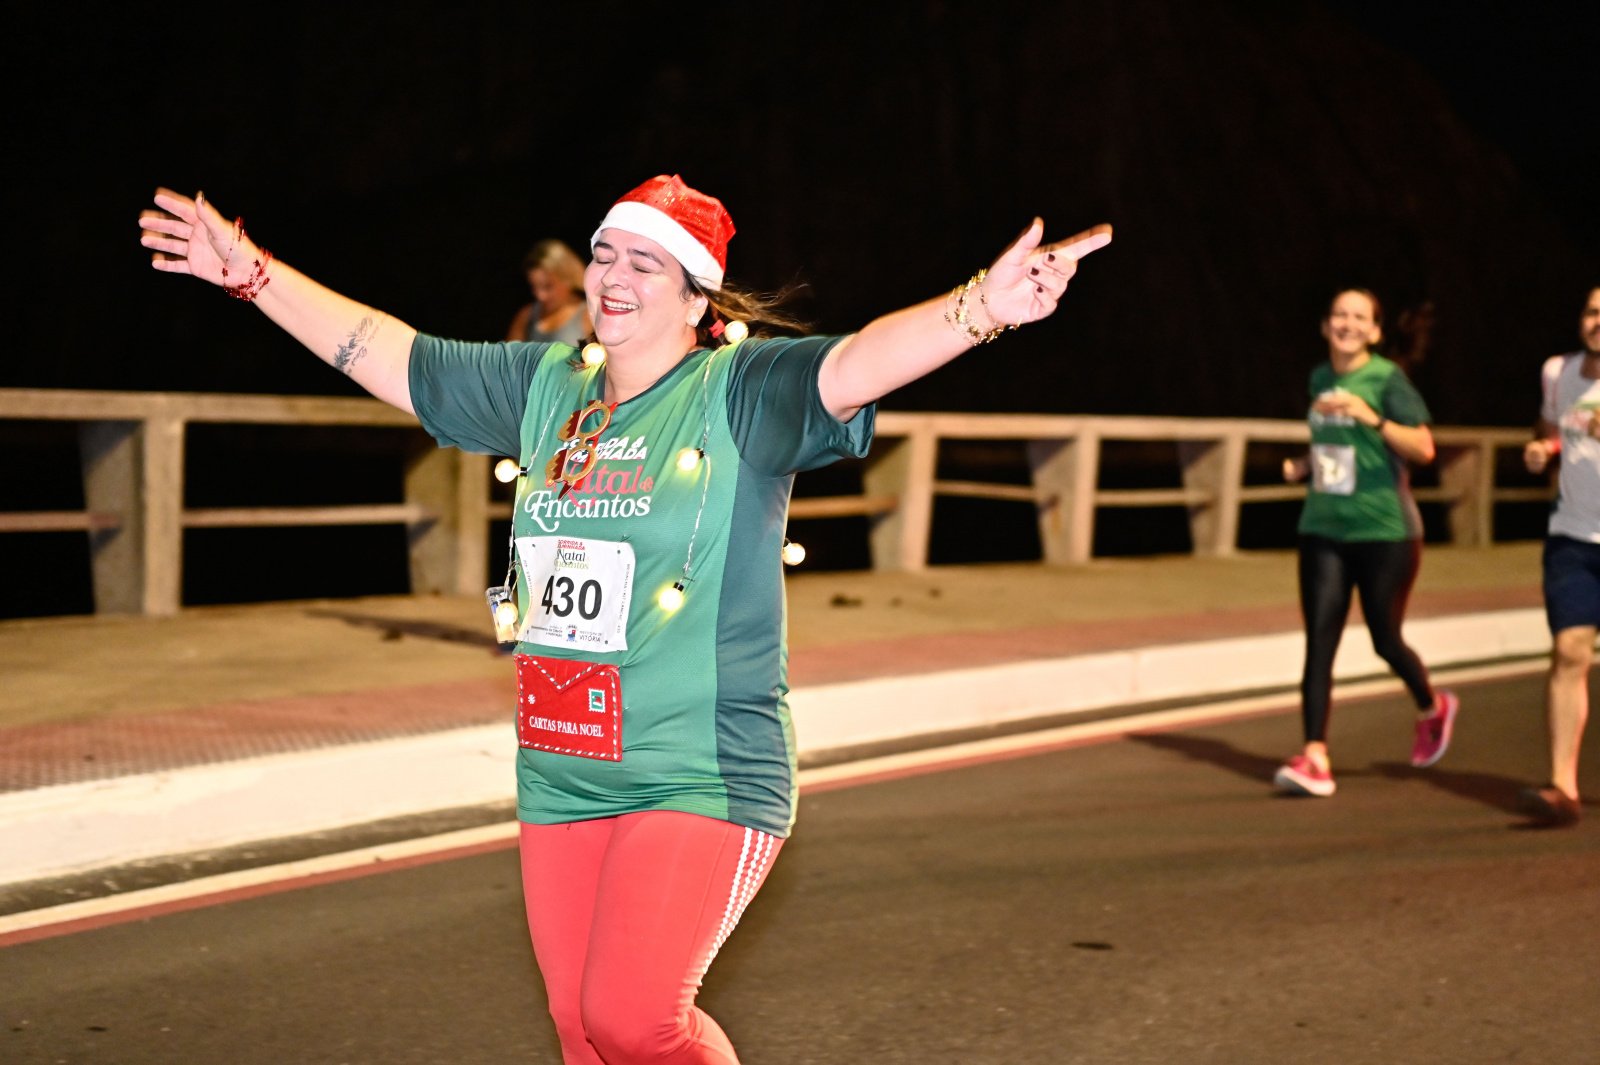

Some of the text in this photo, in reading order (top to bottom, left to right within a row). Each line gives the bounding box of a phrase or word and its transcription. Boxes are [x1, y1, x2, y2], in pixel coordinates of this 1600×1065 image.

[524, 490, 652, 532] Encantos
[556, 548, 586, 565] Natal
[541, 575, 603, 620] 430
[529, 716, 604, 737] CARTAS PARA NOEL
